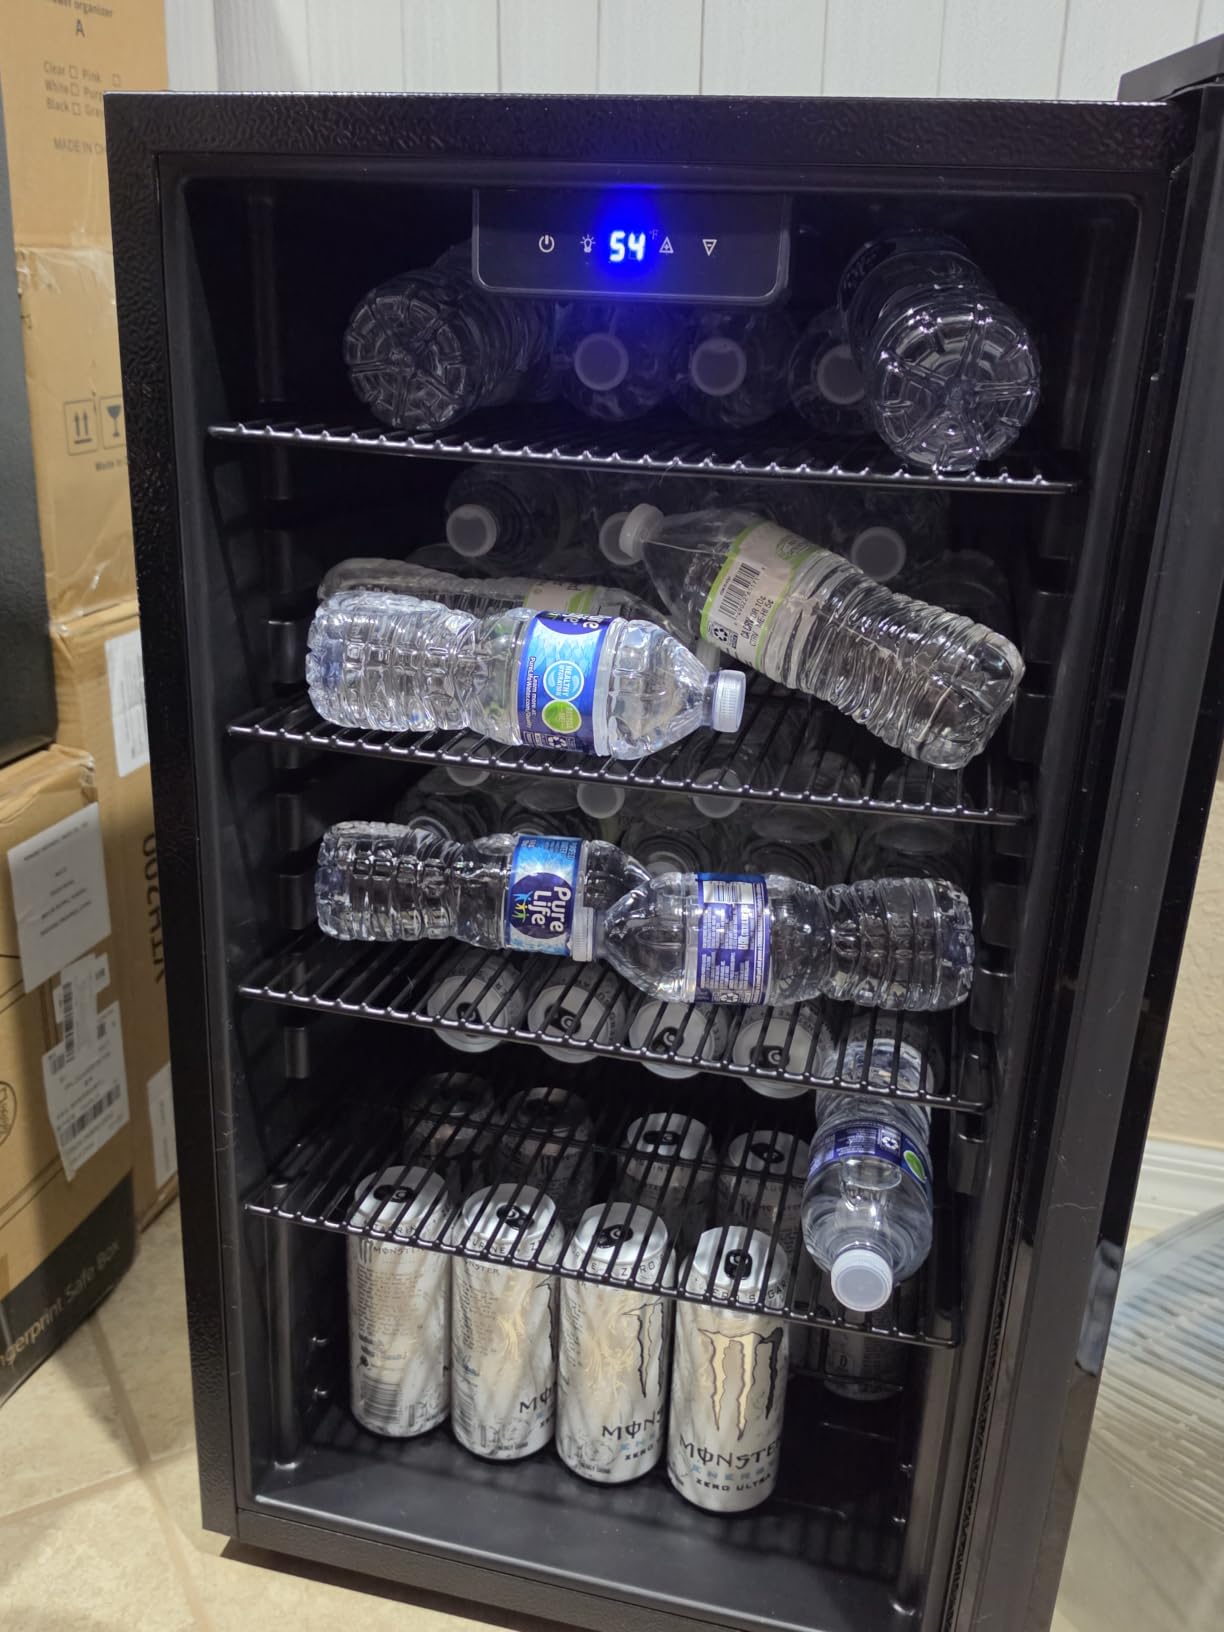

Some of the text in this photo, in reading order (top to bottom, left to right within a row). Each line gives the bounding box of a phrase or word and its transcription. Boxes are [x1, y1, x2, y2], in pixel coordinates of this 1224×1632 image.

[75, 18, 86, 37] A
[609, 229, 647, 262] 54
[528, 890, 552, 925] Life
[550, 886, 572, 933] Pure
[696, 1473, 772, 1492] ZERO ULTRA
